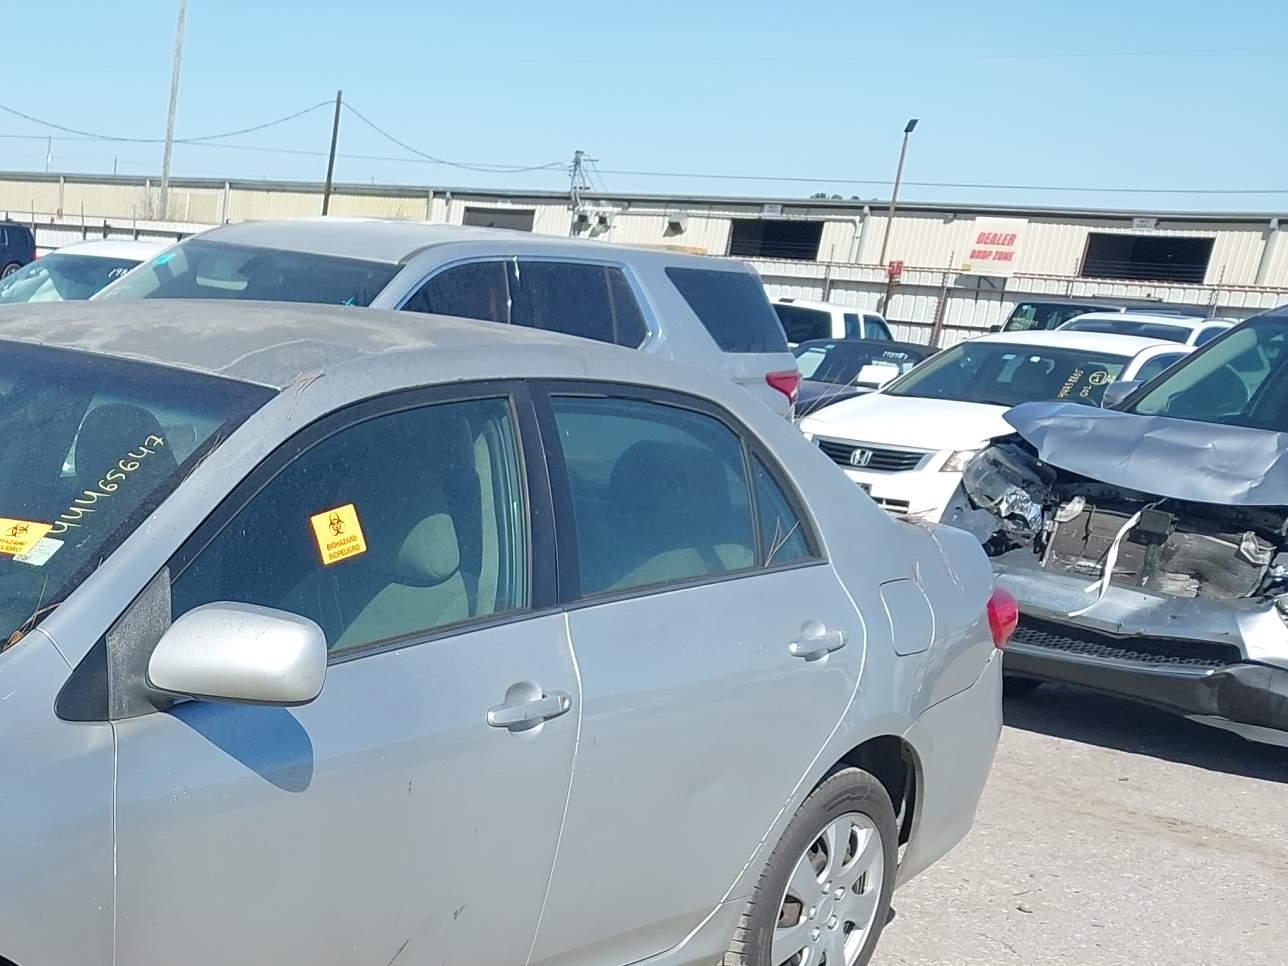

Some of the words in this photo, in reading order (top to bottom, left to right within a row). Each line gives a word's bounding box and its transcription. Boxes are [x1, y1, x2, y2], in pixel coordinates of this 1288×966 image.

[975, 231, 1017, 246] DEALER
[969, 249, 993, 260] DROP
[993, 250, 1015, 262] ZONE
[48, 434, 165, 534] 44465647
[327, 535, 358, 551] BIOHAZARD
[329, 544, 361, 560] BIOPELIGRO
